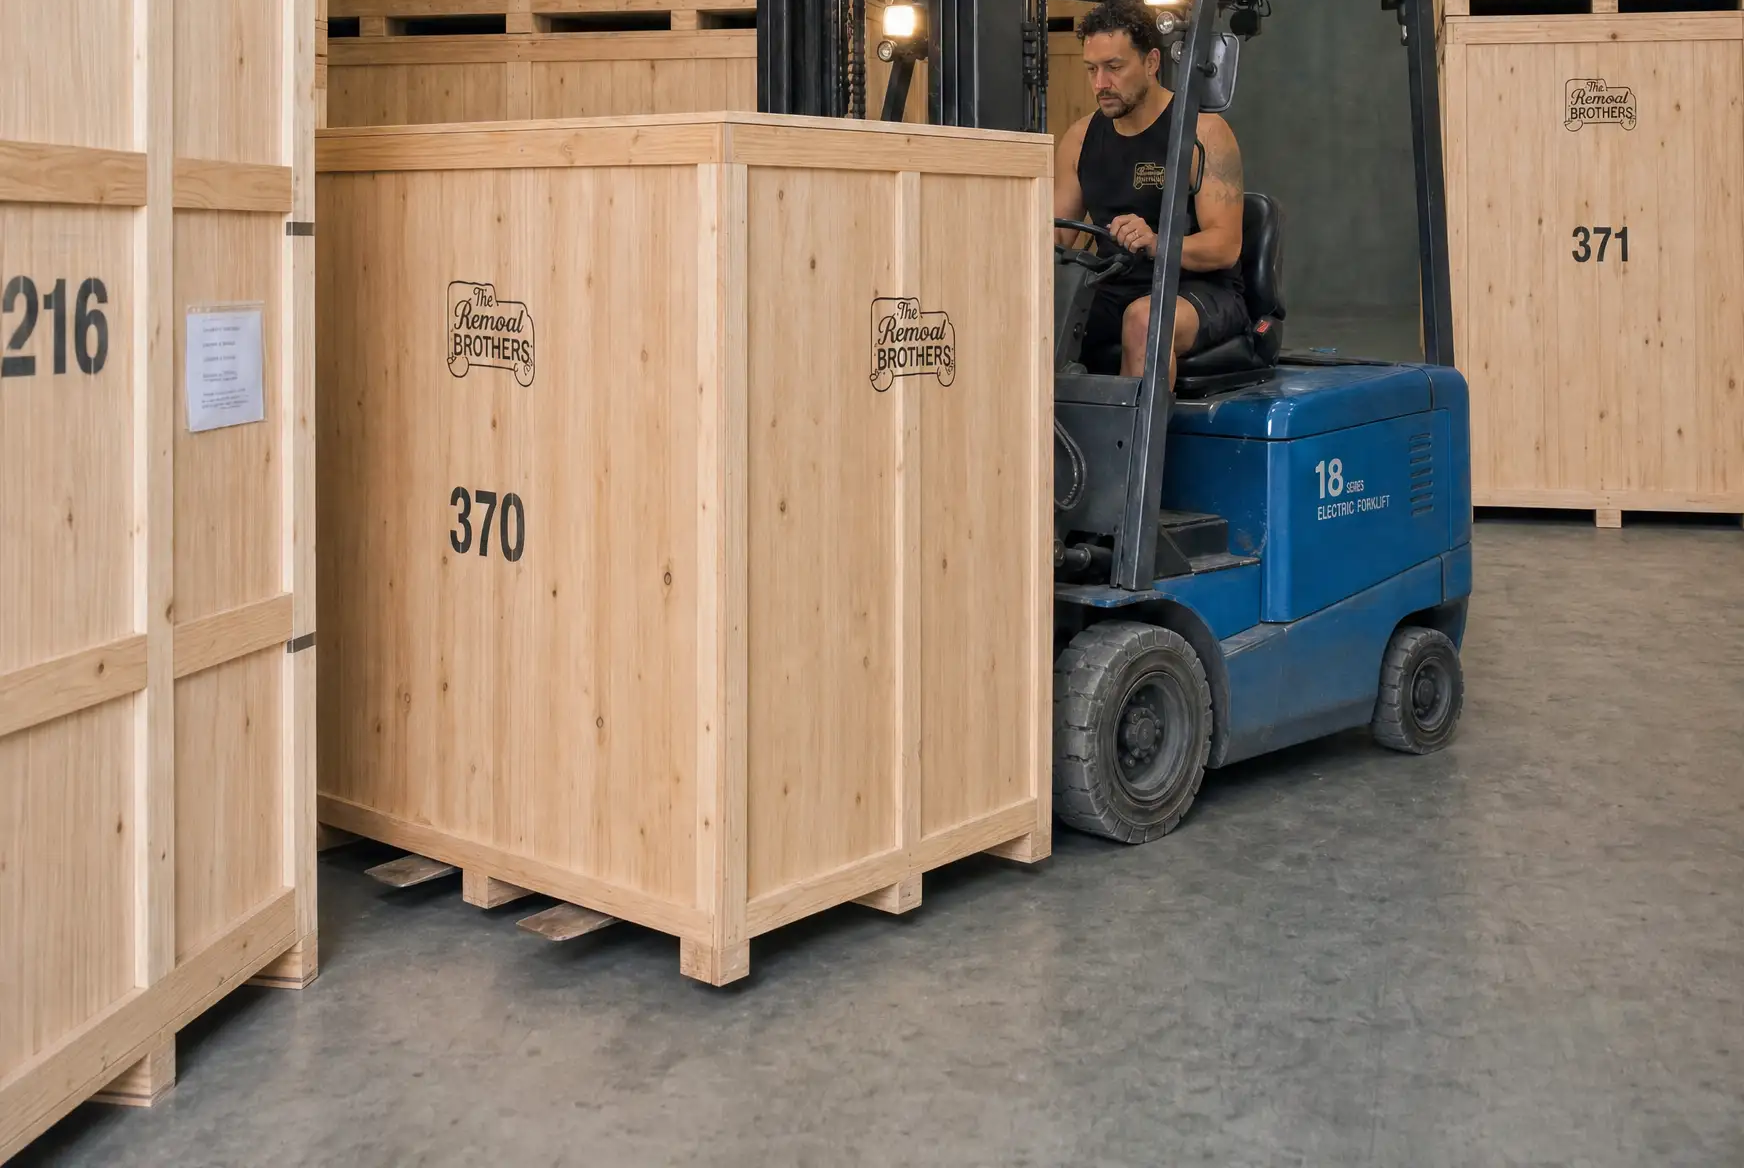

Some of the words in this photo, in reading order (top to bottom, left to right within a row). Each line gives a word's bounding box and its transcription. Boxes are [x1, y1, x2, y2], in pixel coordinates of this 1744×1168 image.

[1571, 88, 1628, 105] Remoal
[1587, 81, 1604, 92] The
[1571, 107, 1633, 119] BROTHERS
[1572, 226, 1628, 262] 371
[473, 287, 493, 307] The
[898, 302, 918, 319] The
[1, 275, 108, 377] 216
[454, 298, 524, 333] Remoal
[878, 314, 946, 345] Remoal
[454, 333, 529, 363] BROTHERS
[878, 345, 951, 370] BROTHERS
[1315, 458, 1344, 499] 18
[1318, 501, 1354, 520] ELECTRIC
[1357, 495, 1390, 512] FORKLIFT
[450, 487, 525, 562] 370
